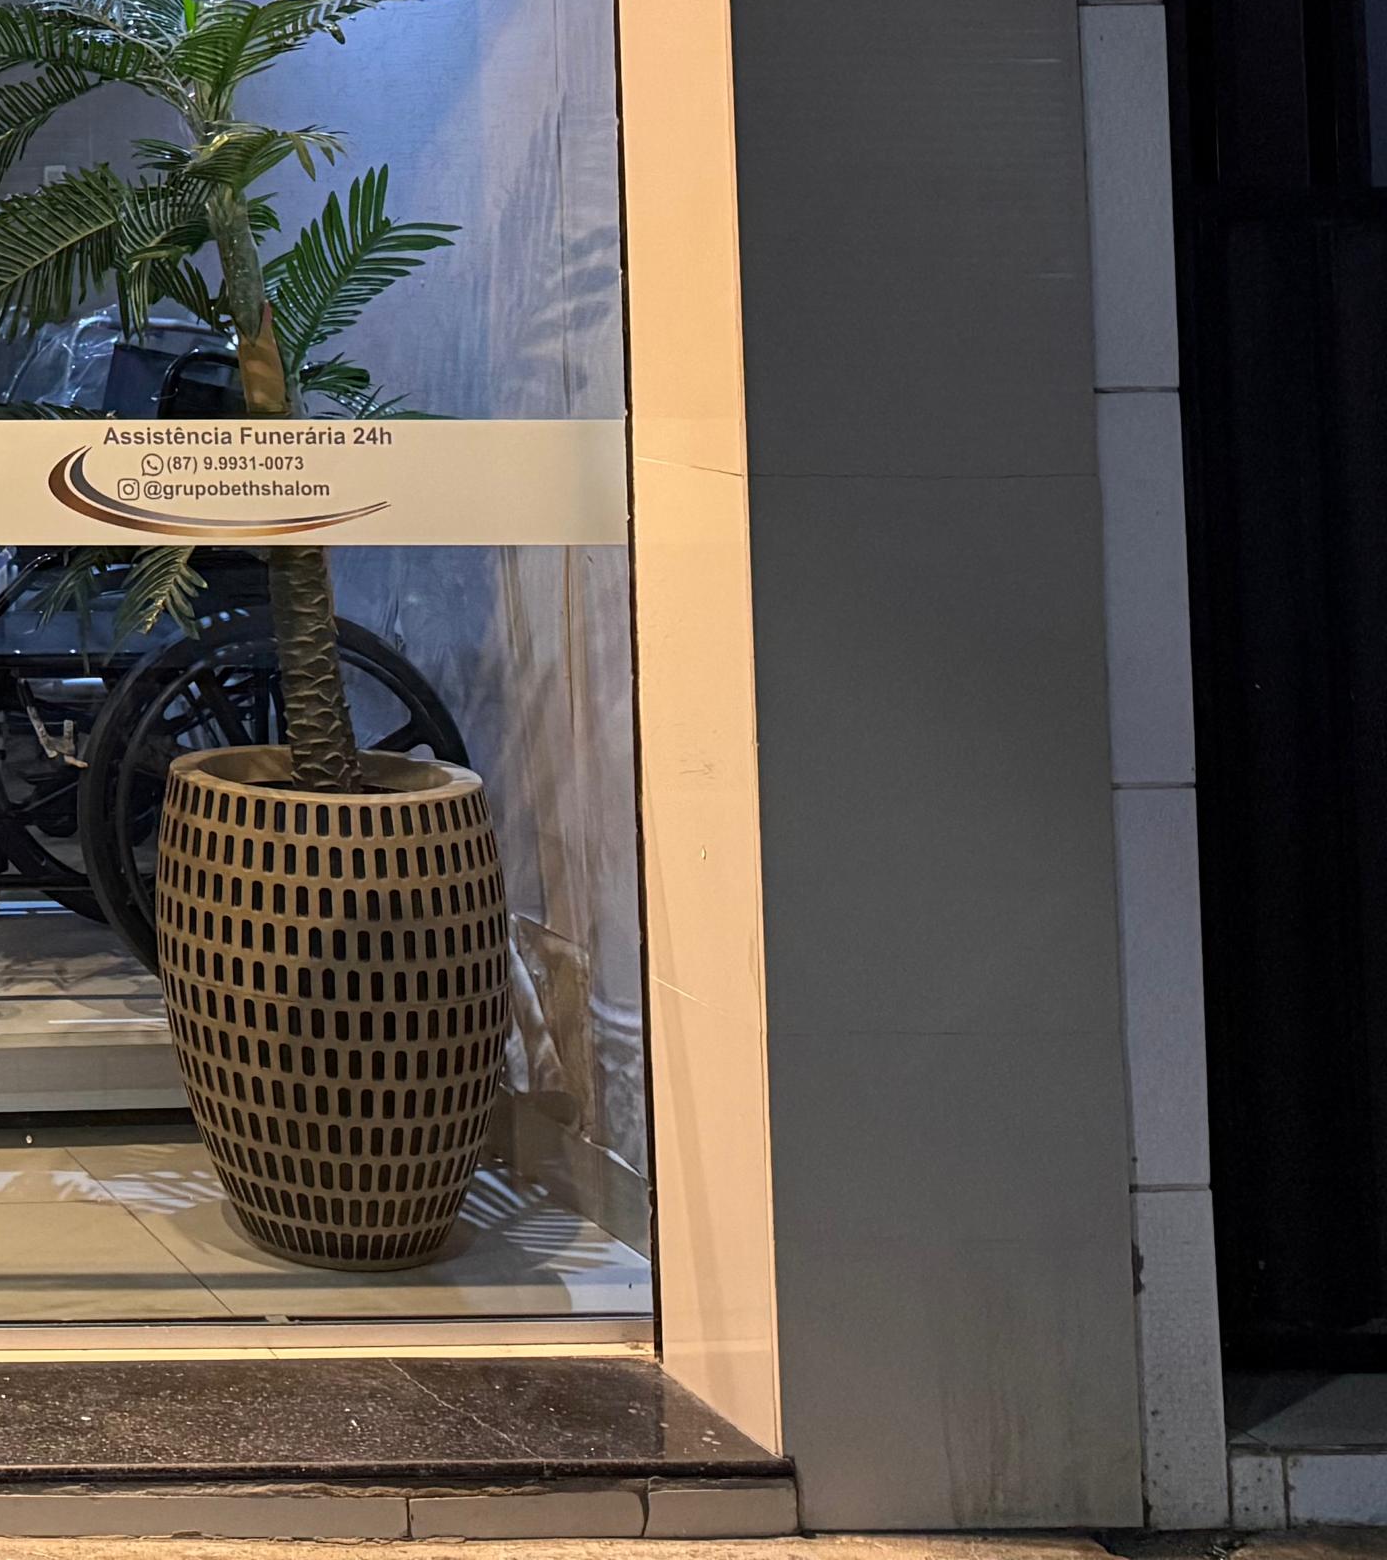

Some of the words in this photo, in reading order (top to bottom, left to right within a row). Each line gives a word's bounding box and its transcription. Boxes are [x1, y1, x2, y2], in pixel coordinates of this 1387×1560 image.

[103, 426, 233, 446] Assistência
[240, 426, 346, 445] Funerária
[353, 426, 392, 445] 24h
[166, 455, 199, 475] (87)
[203, 456, 305, 471] 9.9931-0073
[143, 480, 330, 500] @grupobethshalom
